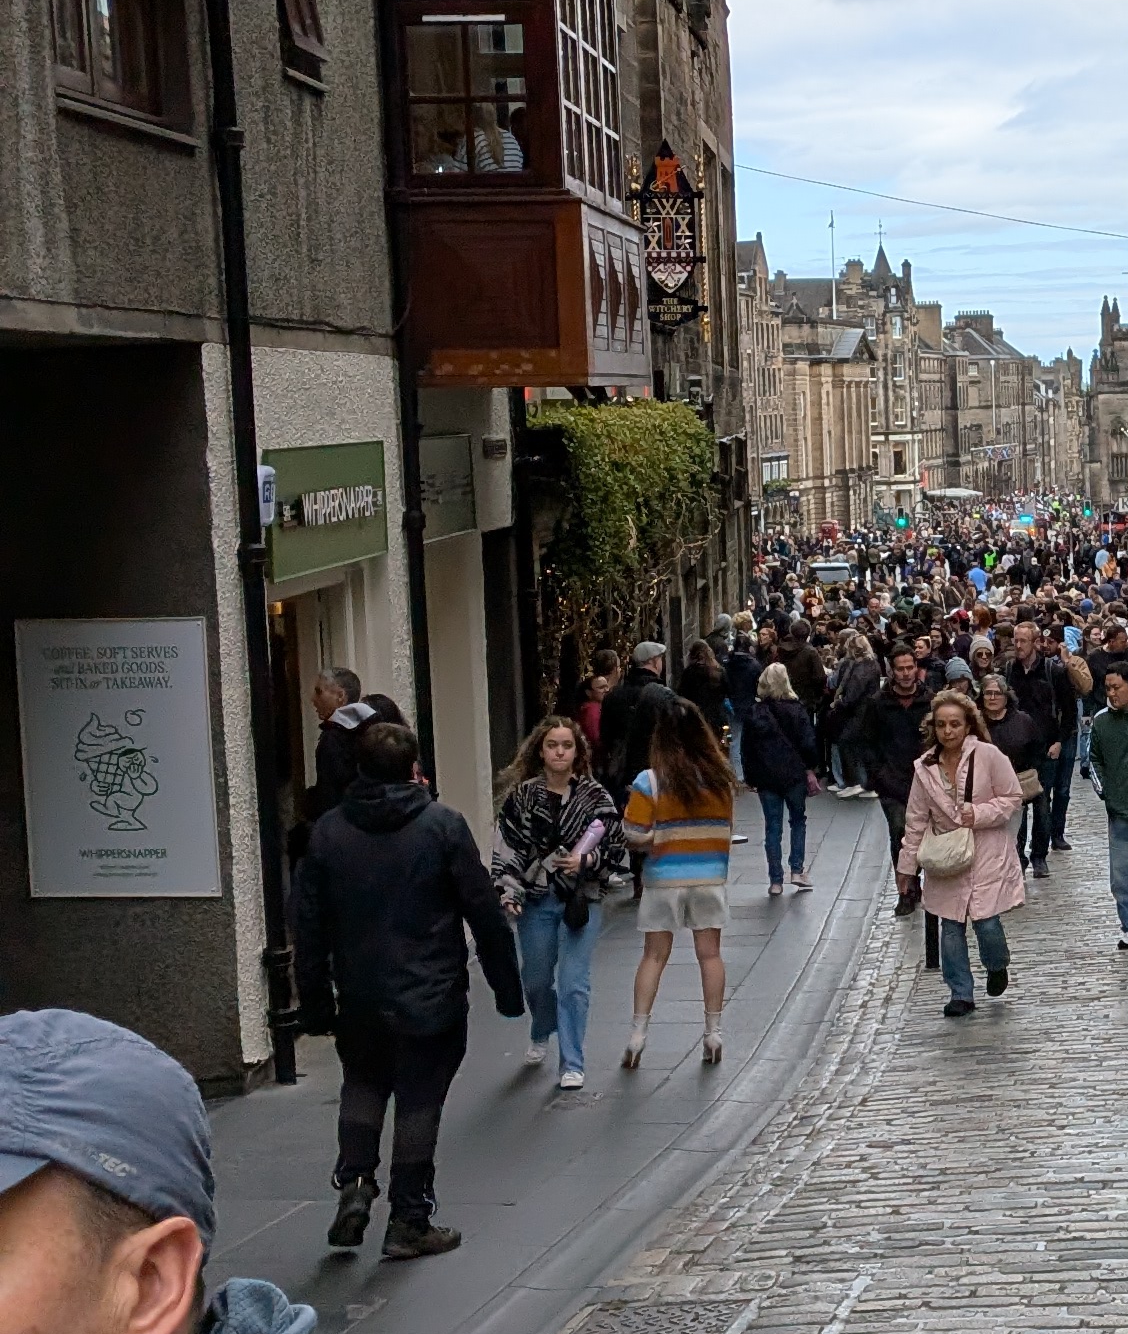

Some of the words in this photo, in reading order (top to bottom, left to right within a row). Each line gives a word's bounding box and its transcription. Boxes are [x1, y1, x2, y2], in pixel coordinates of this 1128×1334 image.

[662, 297, 679, 305] THE
[649, 305, 694, 313] WITCHERY
[660, 313, 682, 321] SHOP
[301, 485, 375, 527] WHIPPERSNAPPER
[96, 646, 128, 659] SOFT
[131, 646, 179, 659] SERVES
[77, 661, 119, 675] BAKED
[121, 661, 169, 675] GOODS.
[102, 676, 173, 690] TAKEAWAY.
[79, 848, 167, 859] WHIPPERSNAPPER
